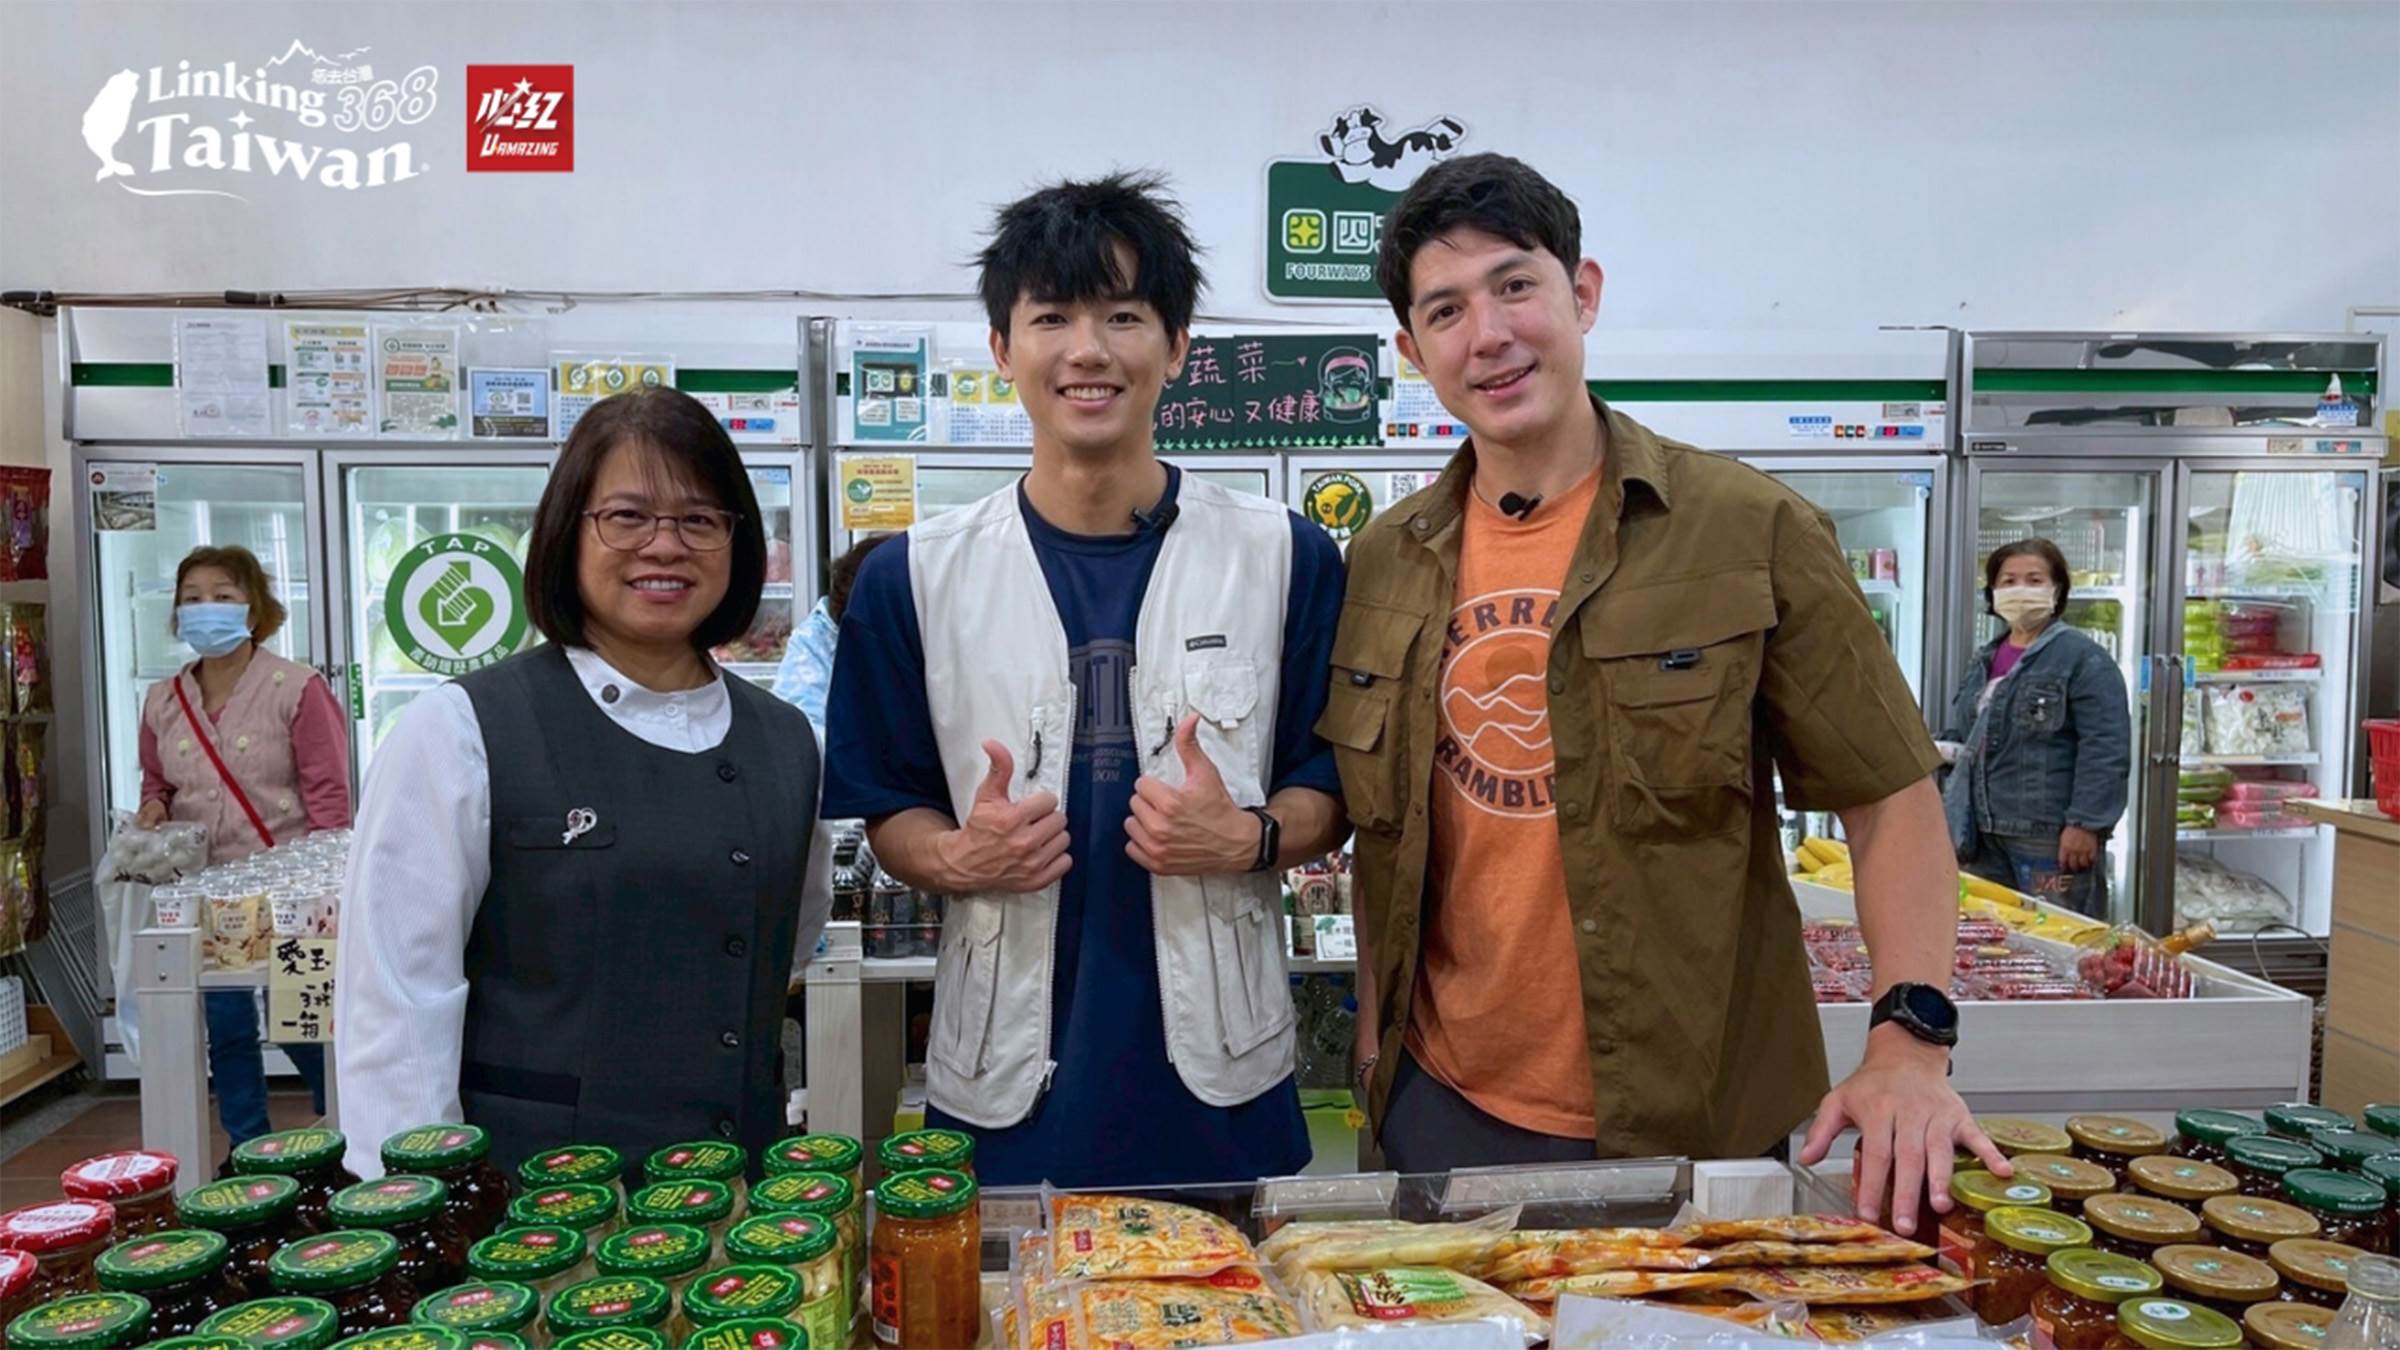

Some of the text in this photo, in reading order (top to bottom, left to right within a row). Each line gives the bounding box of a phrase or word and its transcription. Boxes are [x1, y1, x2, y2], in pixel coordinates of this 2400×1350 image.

[1333, 211, 1384, 254] 四
[1285, 262, 1371, 281] FOURWAYS
[420, 537, 490, 554] TAP
